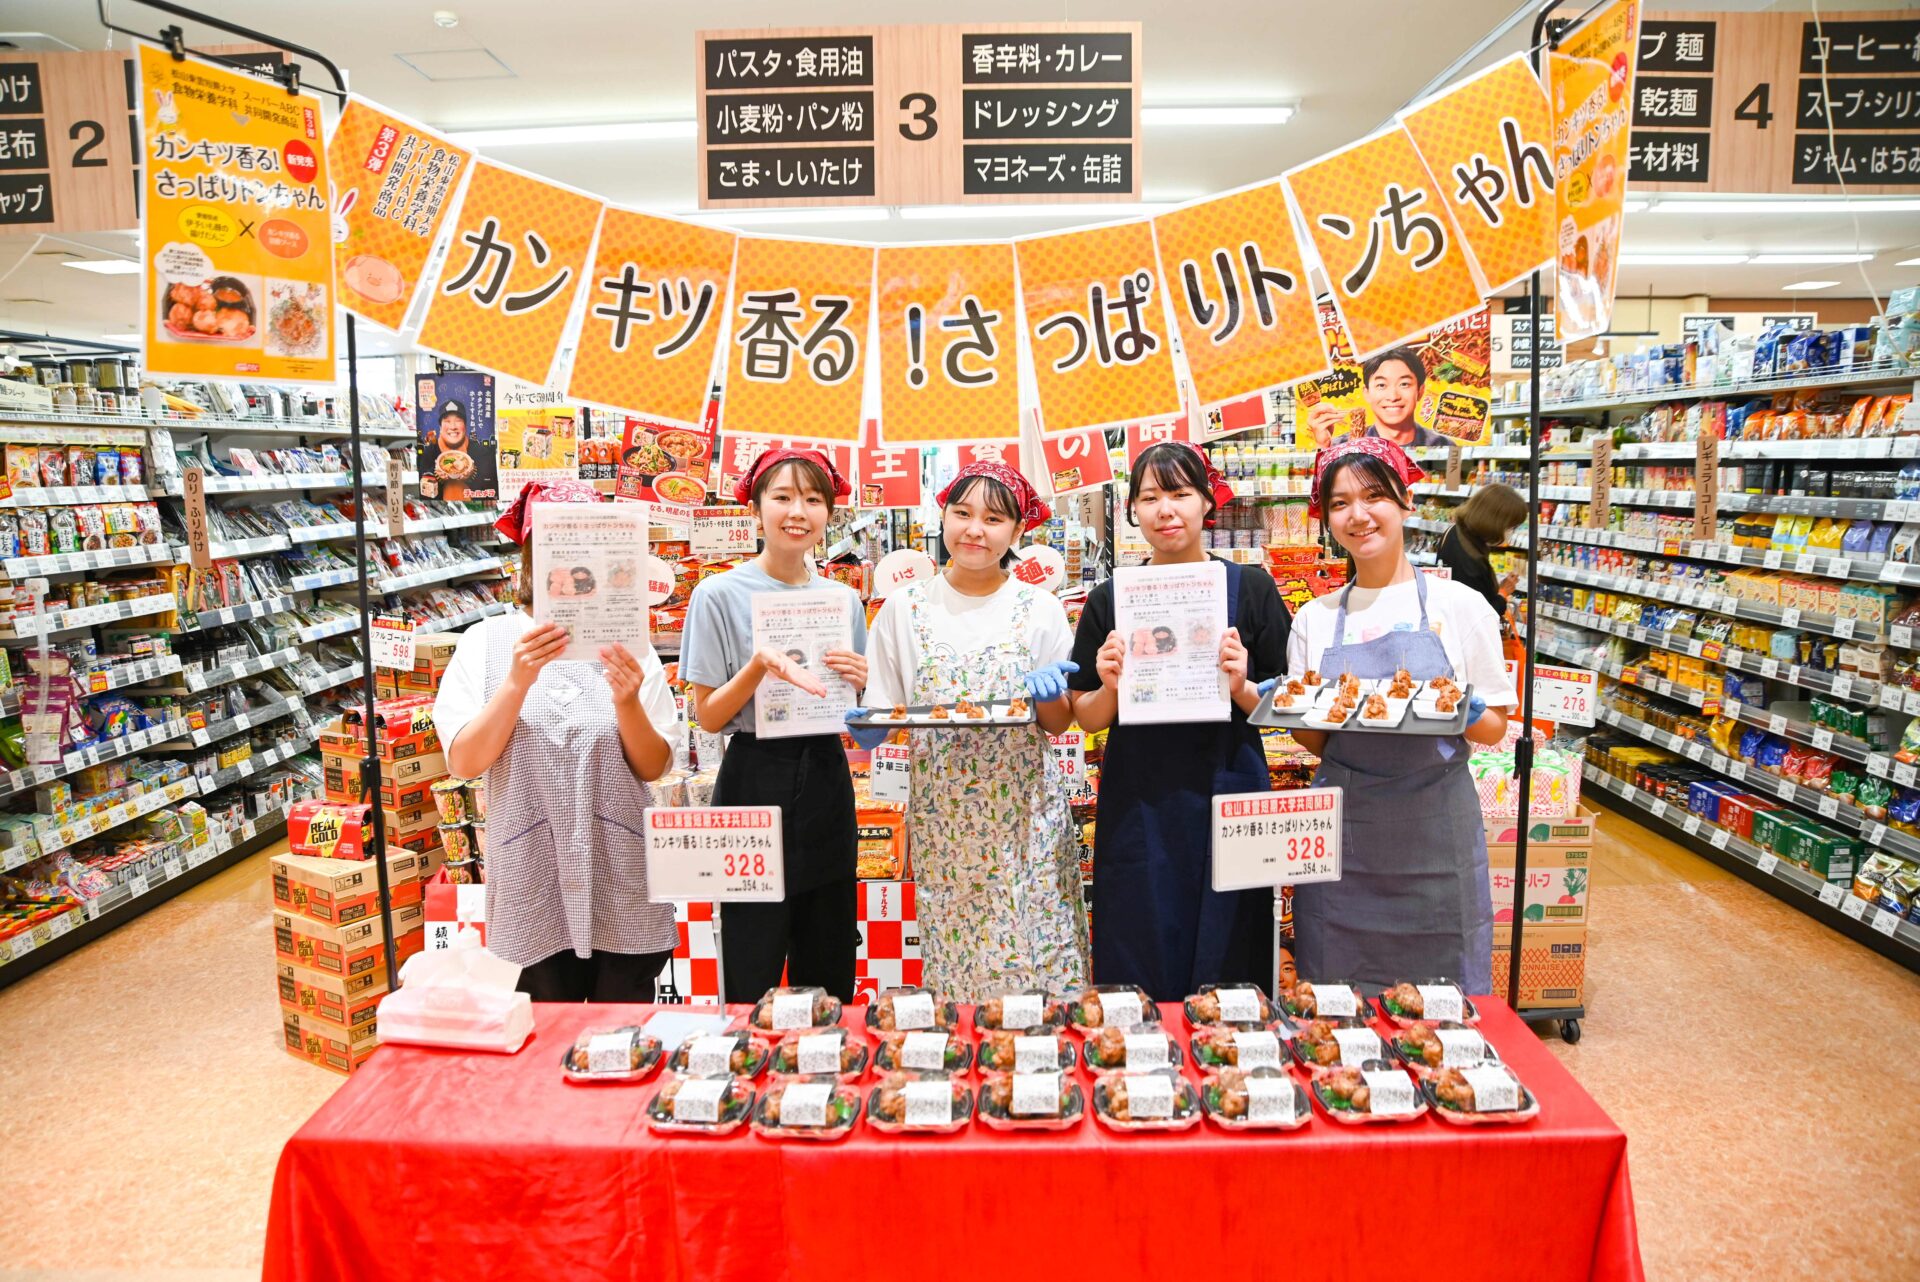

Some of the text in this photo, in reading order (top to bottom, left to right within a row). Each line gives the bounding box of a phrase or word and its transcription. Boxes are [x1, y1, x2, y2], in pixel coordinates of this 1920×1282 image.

[716, 46, 863, 79] パスタ・食用油
[972, 43, 1123, 74] 香辛料・カレー
[716, 101, 864, 134] 小麦粉・パン粉
[899, 93, 938, 140] 3
[973, 99, 1119, 128] ドレッシング
[1640, 88, 1698, 117] 乾麺
[1735, 83, 1773, 129] 4
[69, 120, 108, 168] 2
[156, 133, 280, 172] カンキツ香る!
[367, 127, 396, 172] 第3弾
[286, 153, 315, 168] 新発売
[719, 157, 863, 187] ごま・しいたけ
[973, 154, 1122, 184] マヨネーズ・缶詰
[156, 170, 325, 209] さっぱりトンちゃん
[372, 135, 417, 218] 共同開発商品
[392, 142, 430, 219] スーパーABC
[403, 148, 446, 231] 食物栄養学科
[1492, 337, 1503, 352] 5
[464, 489, 496, 497] チャルメラ
[1595, 443, 1605, 524] インスタントコーヒー
[1701, 441, 1713, 535] レギュラーコーヒー
[188, 472, 204, 552] のり・ふりかけ
[729, 529, 749, 541] 298
[892, 567, 915, 583] いざ
[393, 644, 409, 658] 598
[1563, 696, 1586, 712] 278
[311, 820, 337, 833] REAL
[312, 830, 338, 844] GOLD
[1287, 836, 1325, 861] 328
[724, 854, 765, 876] 328
